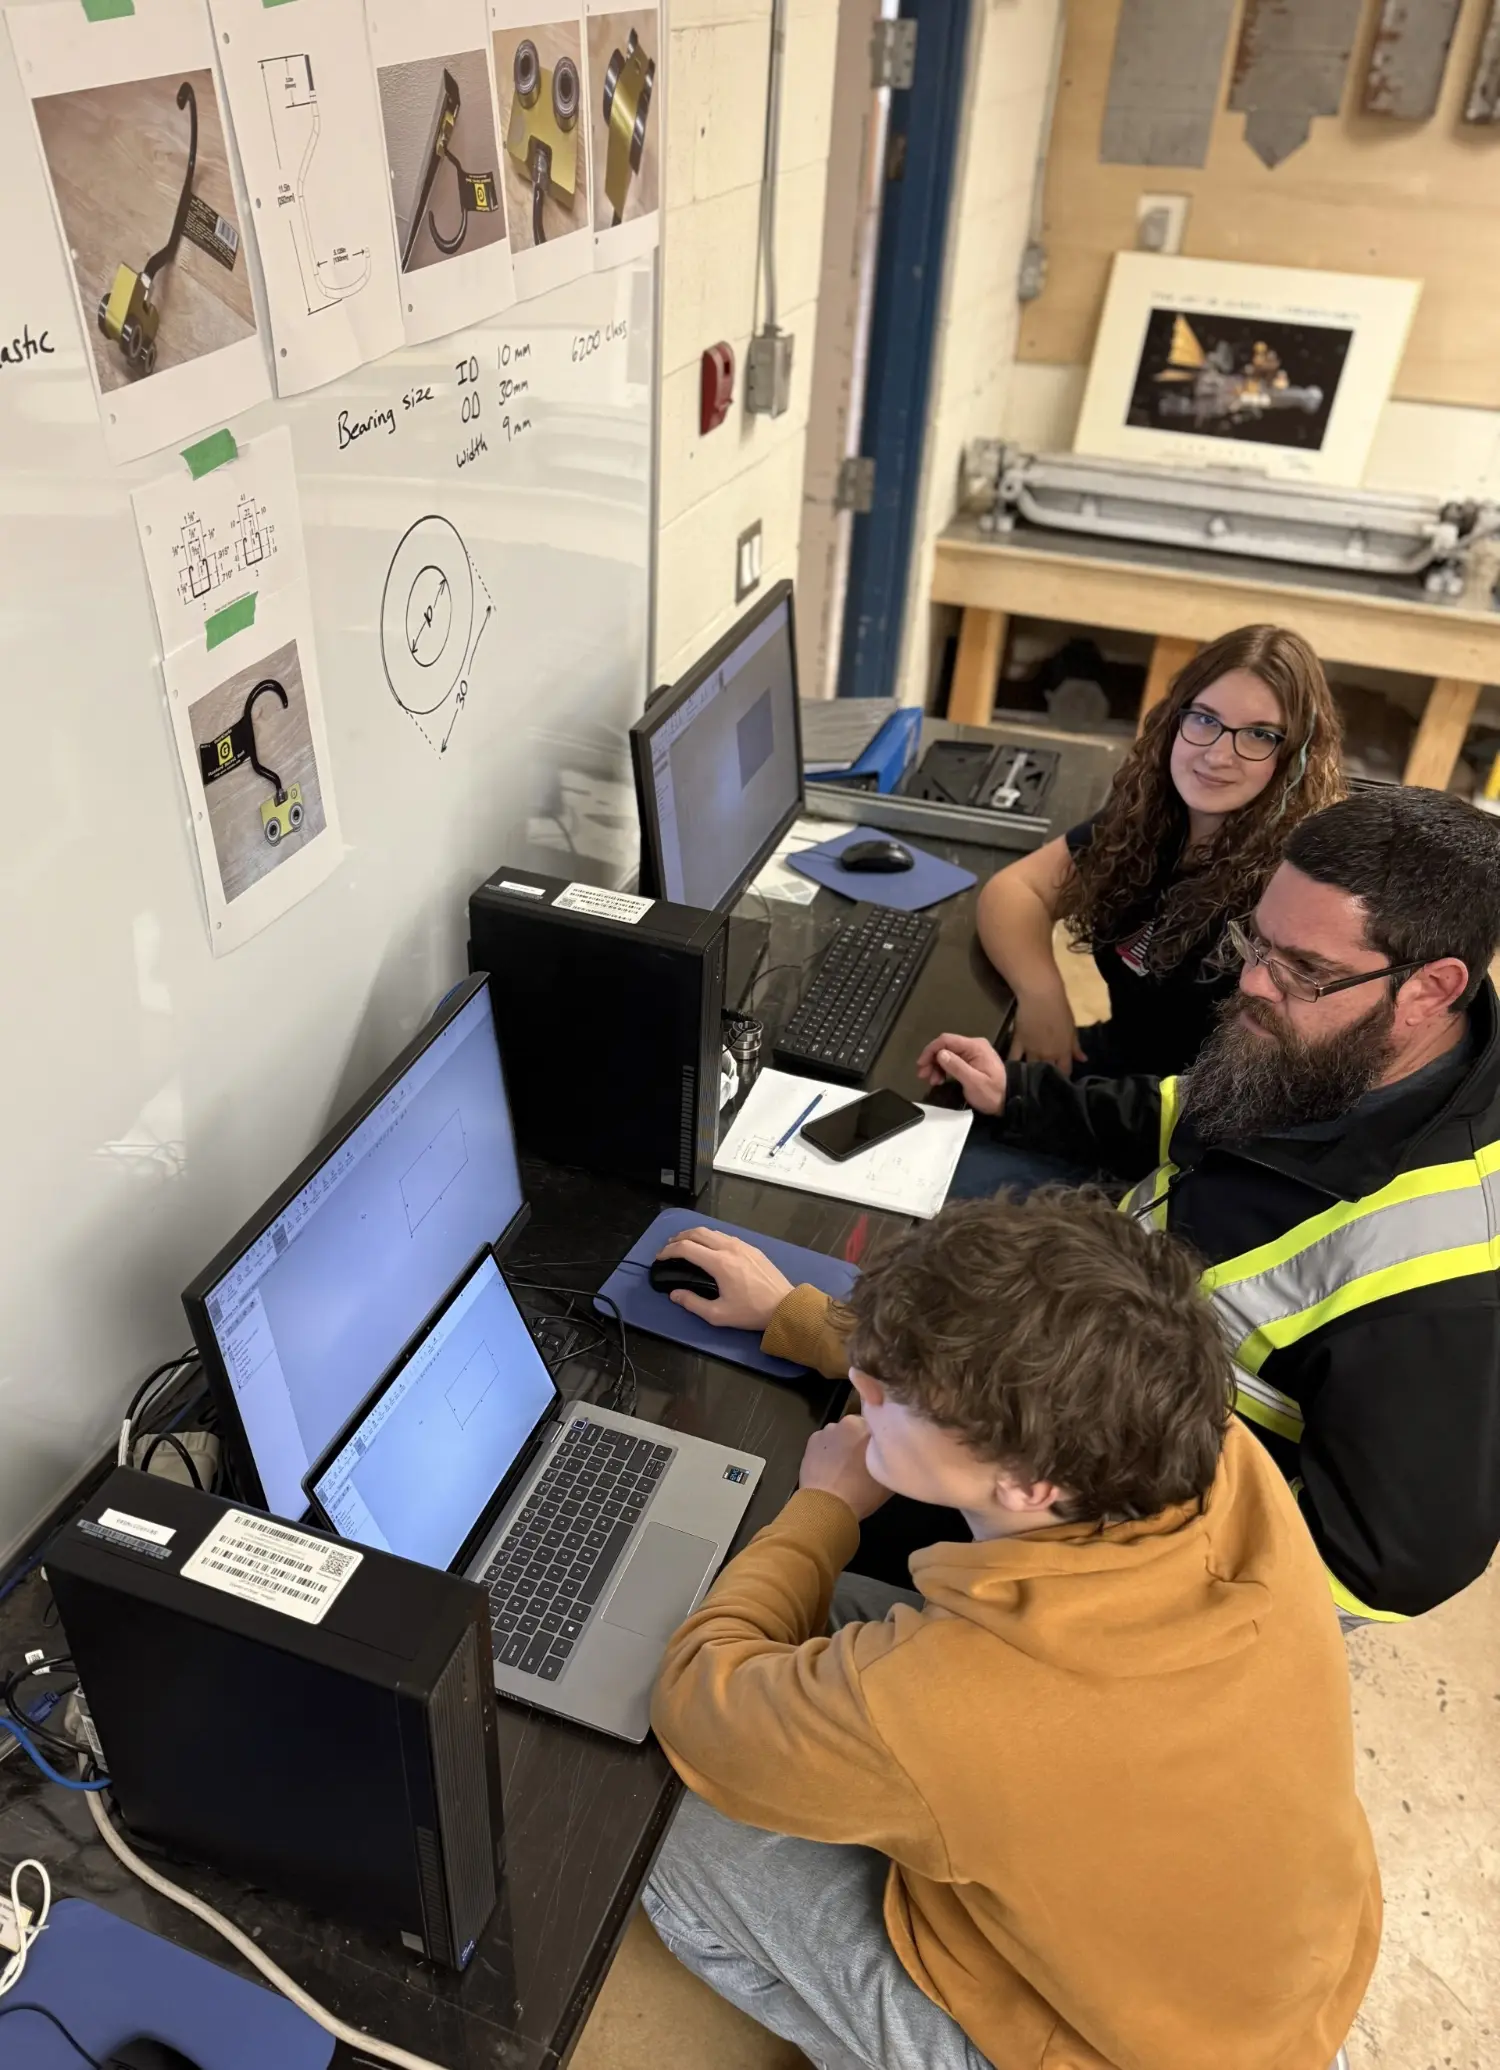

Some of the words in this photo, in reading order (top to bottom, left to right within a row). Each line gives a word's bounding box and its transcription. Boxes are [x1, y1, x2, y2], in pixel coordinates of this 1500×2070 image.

[0, 324, 55, 369] astic
[571, 329, 601, 362] 6200
[455, 355, 479, 386] ID
[497, 344, 511, 370] 10
[338, 409, 396, 450] Bearing
[402, 386, 434, 410] size
[461, 391, 480, 423] OD
[502, 415, 511, 442] 9
[455, 680, 468, 711] 30
